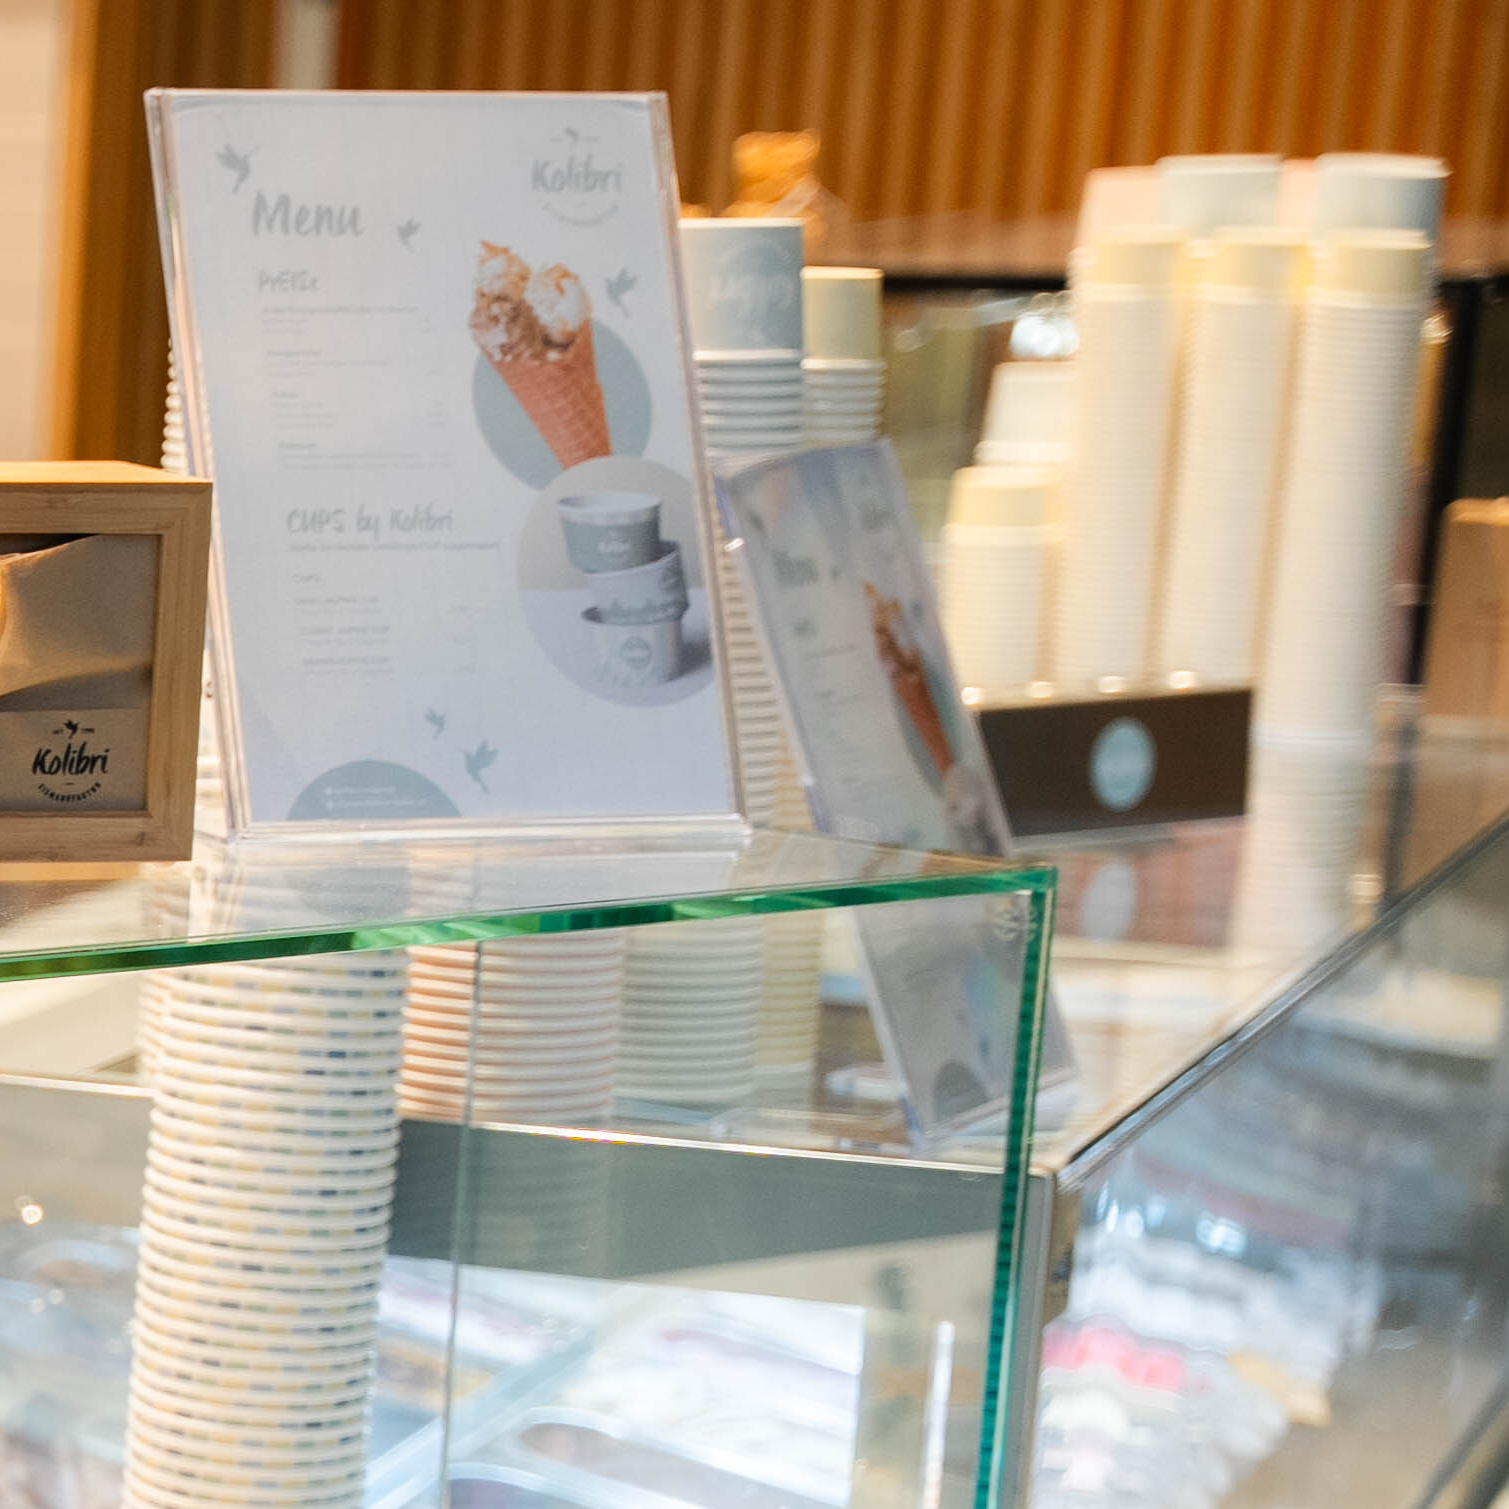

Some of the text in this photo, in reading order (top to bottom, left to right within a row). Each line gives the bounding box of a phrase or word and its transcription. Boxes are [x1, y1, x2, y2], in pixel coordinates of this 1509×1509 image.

[531, 153, 624, 192] Kolibri
[252, 190, 366, 238] Menu
[286, 503, 454, 542] CUPS by Kolibri
[32, 740, 111, 775] Kolibri
